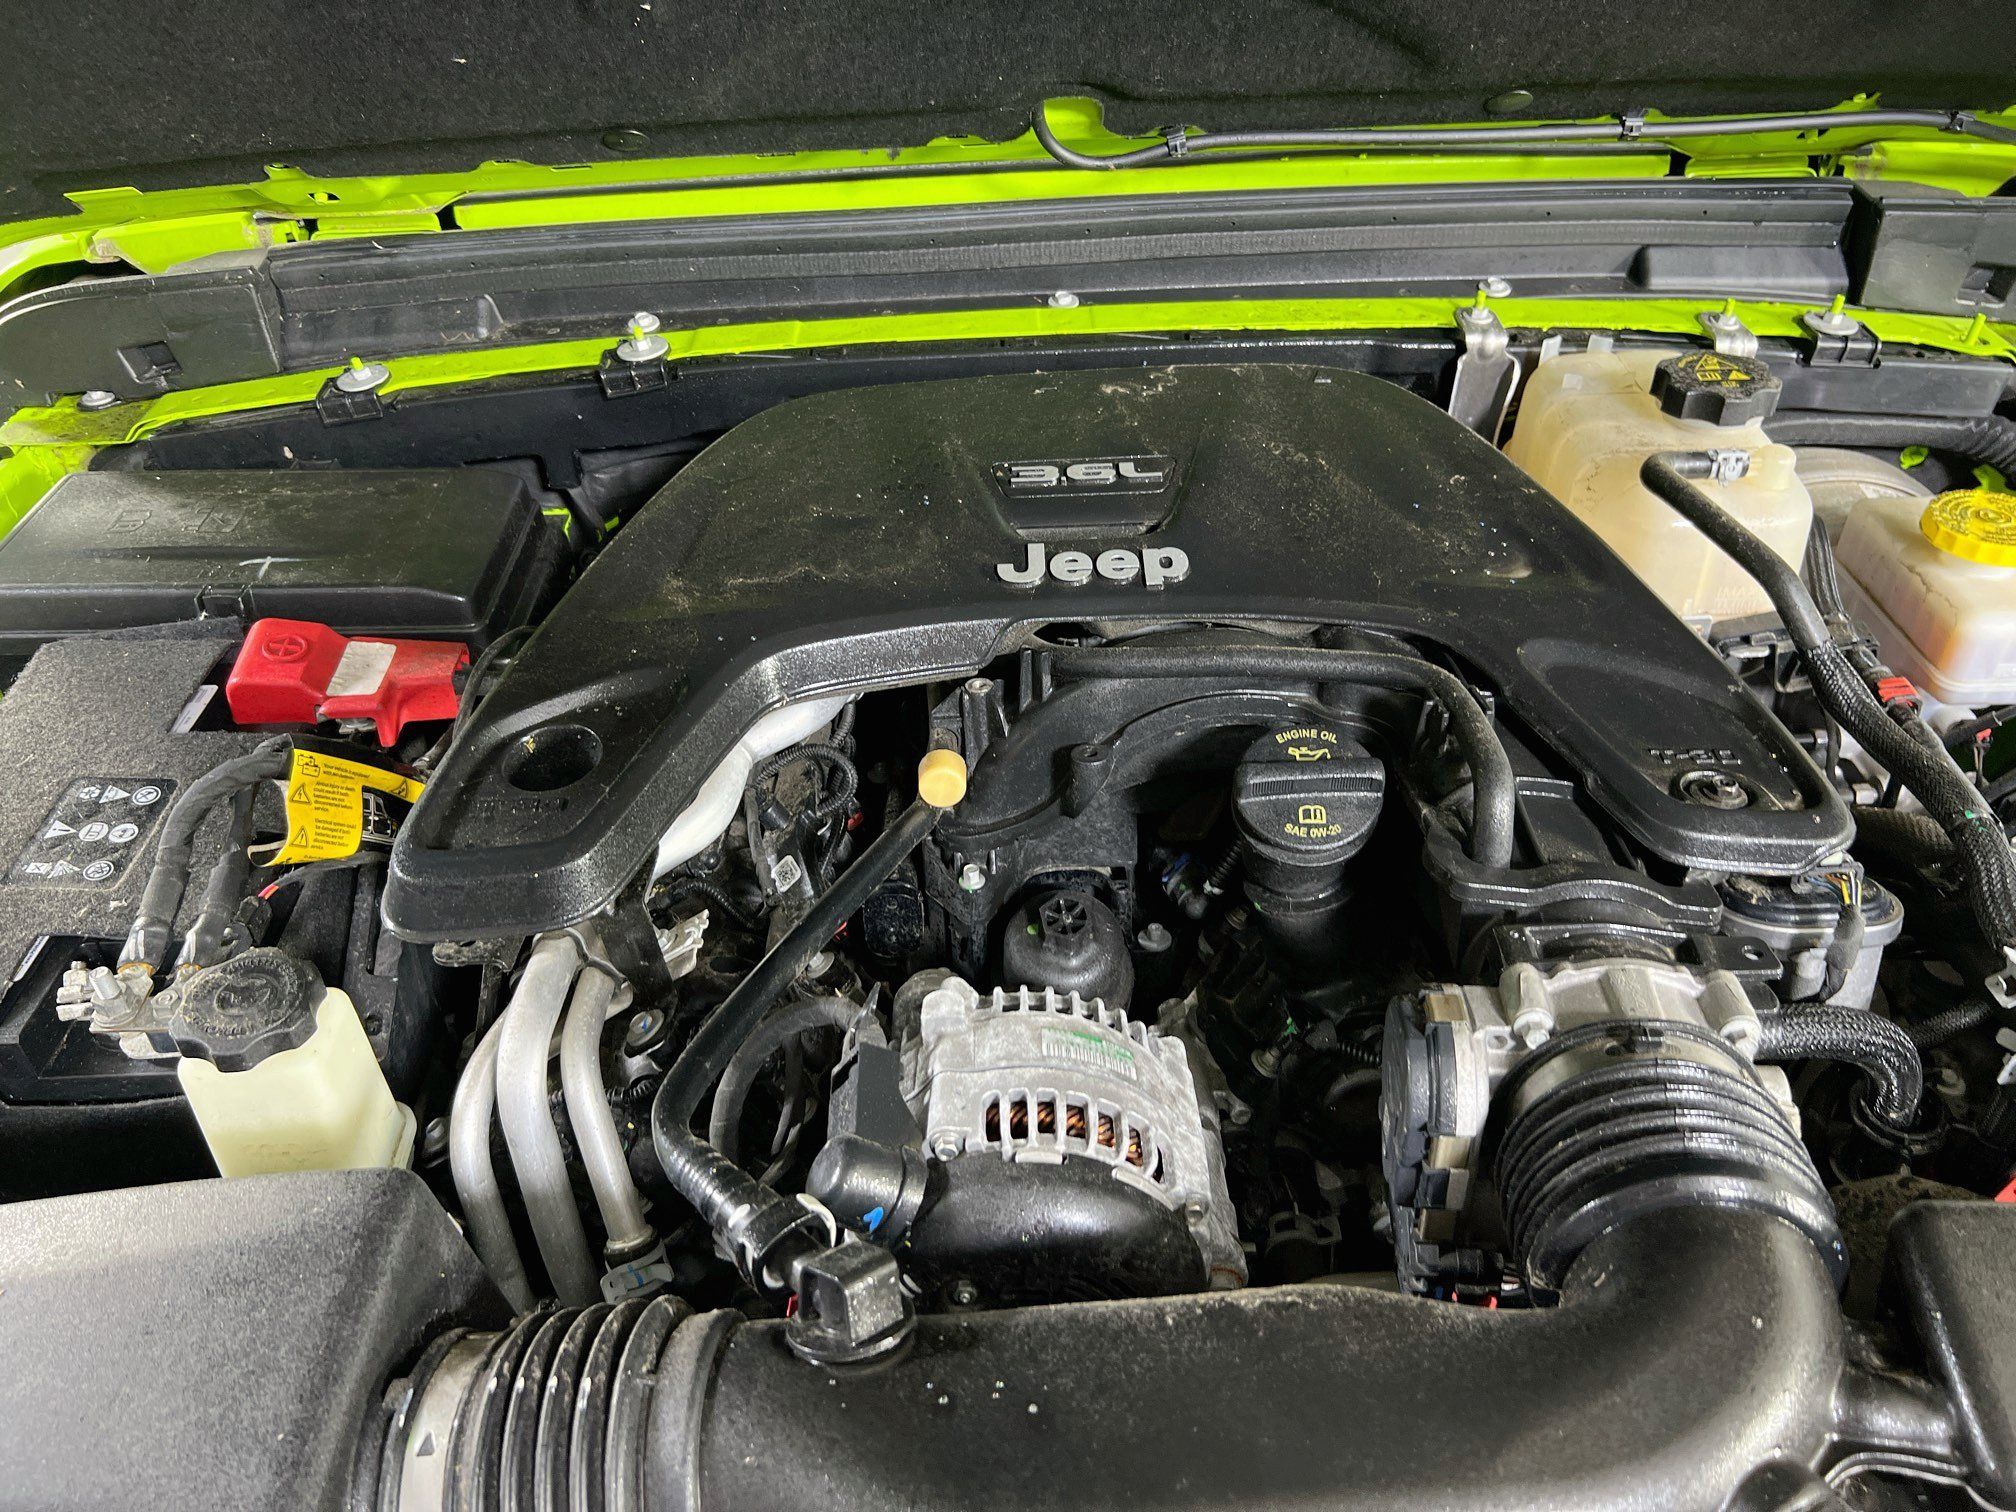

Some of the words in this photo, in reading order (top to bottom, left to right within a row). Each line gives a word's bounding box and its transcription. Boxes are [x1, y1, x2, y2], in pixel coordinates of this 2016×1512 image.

[1010, 461, 1163, 488] 3.6L
[997, 542, 1190, 590] Jeep
[1275, 728, 1318, 744] ENGINE
[1320, 730, 1338, 744] OIL
[1284, 822, 1308, 837] SAE
[1310, 823, 1342, 839] 0W-20
